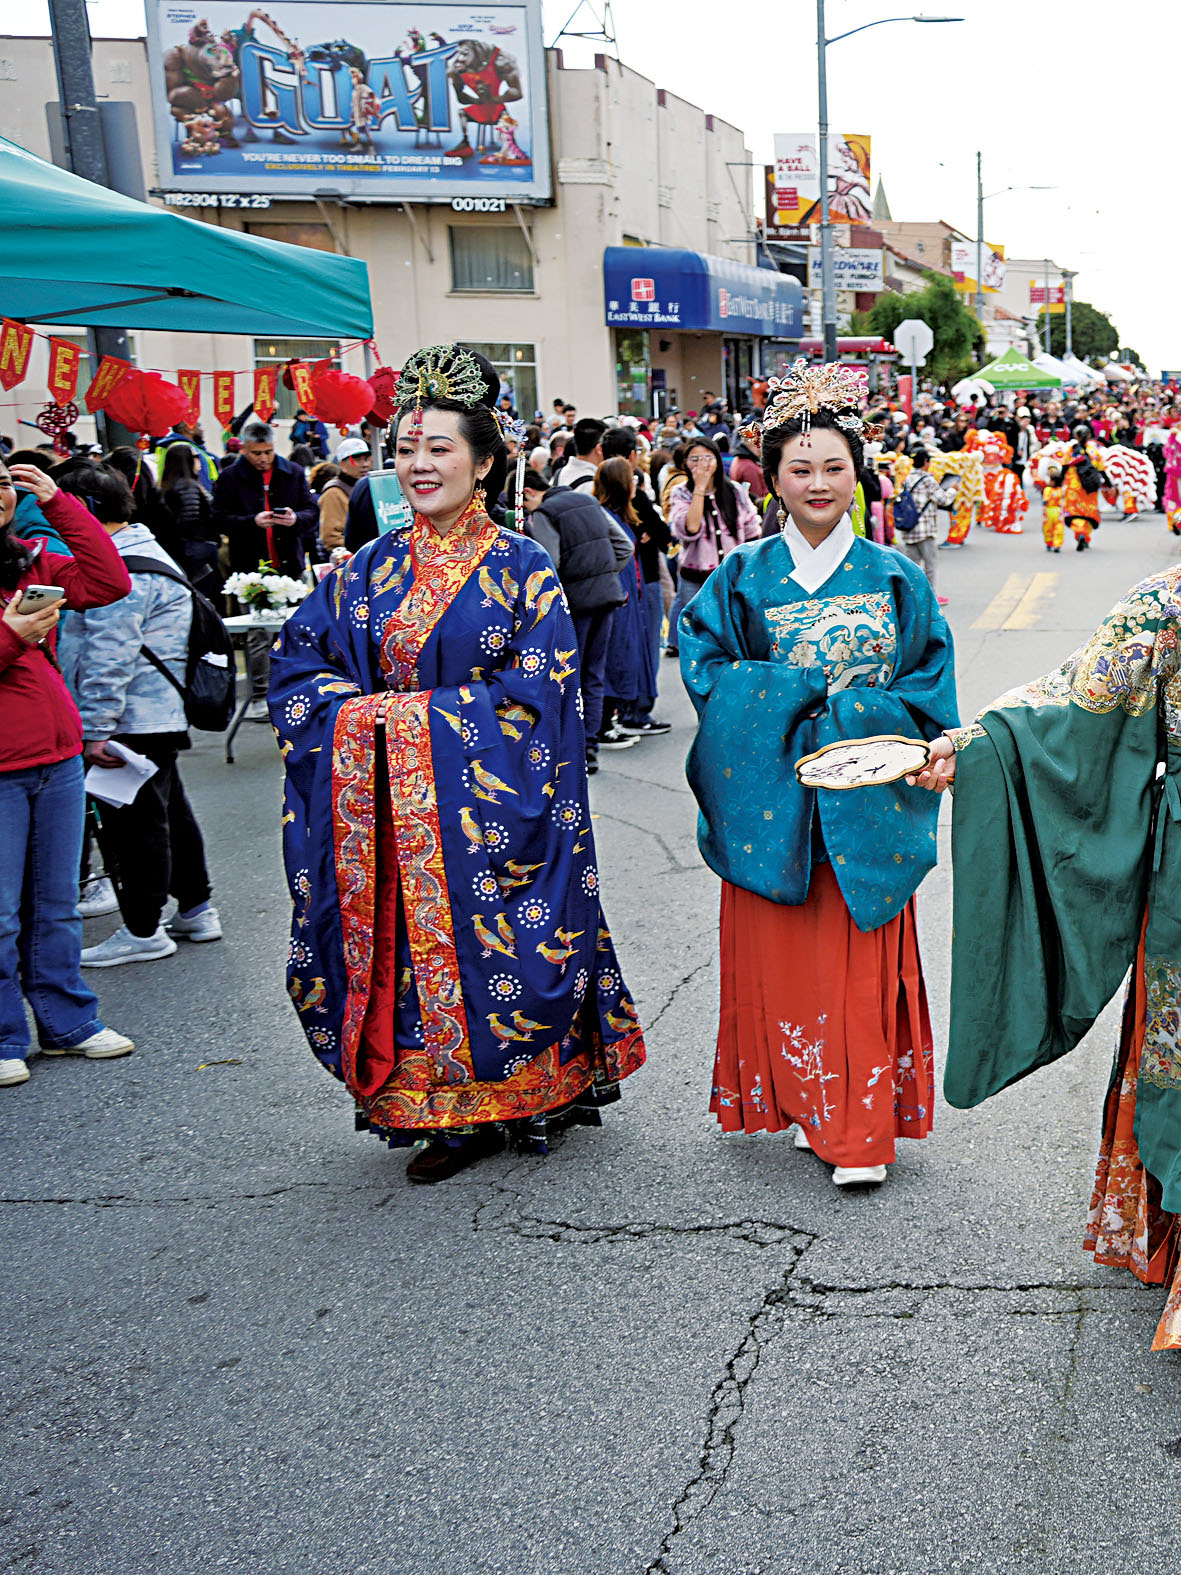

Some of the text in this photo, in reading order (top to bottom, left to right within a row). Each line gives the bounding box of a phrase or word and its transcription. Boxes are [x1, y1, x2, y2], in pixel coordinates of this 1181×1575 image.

[240, 40, 460, 135] GOAT
[241, 153, 463, 166] YOU'RE NEVER TOO SMALL TO DREAM BIG
[452, 198, 506, 212] 001021
[812, 260, 880, 271] HDWARE
[1, 327, 315, 413] NEW YEAR
